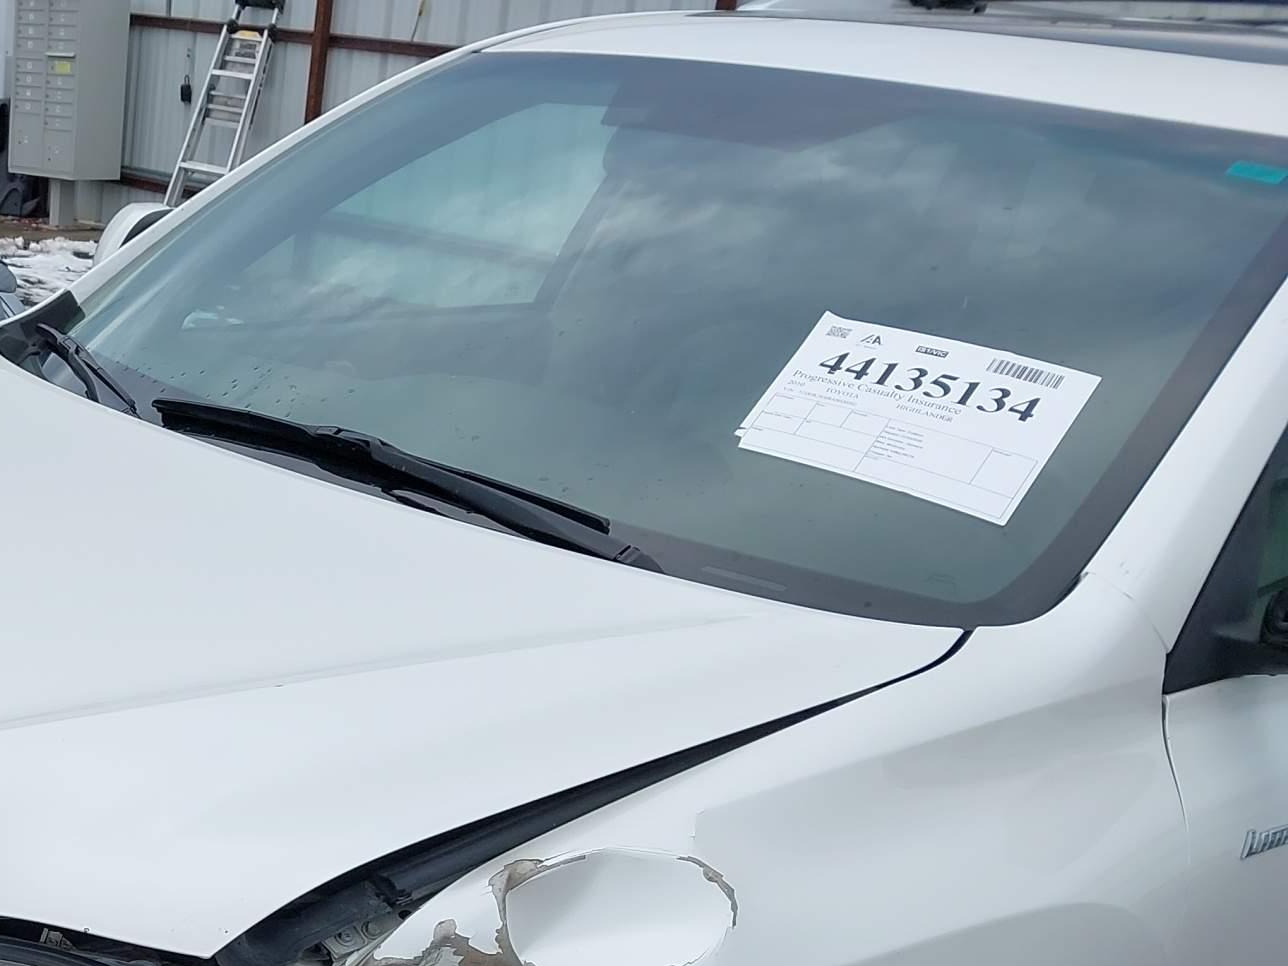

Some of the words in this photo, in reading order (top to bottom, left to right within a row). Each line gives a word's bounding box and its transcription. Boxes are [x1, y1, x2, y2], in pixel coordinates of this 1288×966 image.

[792, 369, 856, 390] Progressive
[857, 381, 906, 403] Casualty
[906, 393, 963, 416] Insurance
[819, 351, 1042, 422] 44135134
[825, 387, 860, 400] TOYOTA
[895, 403, 954, 424] HIGHLANDER
